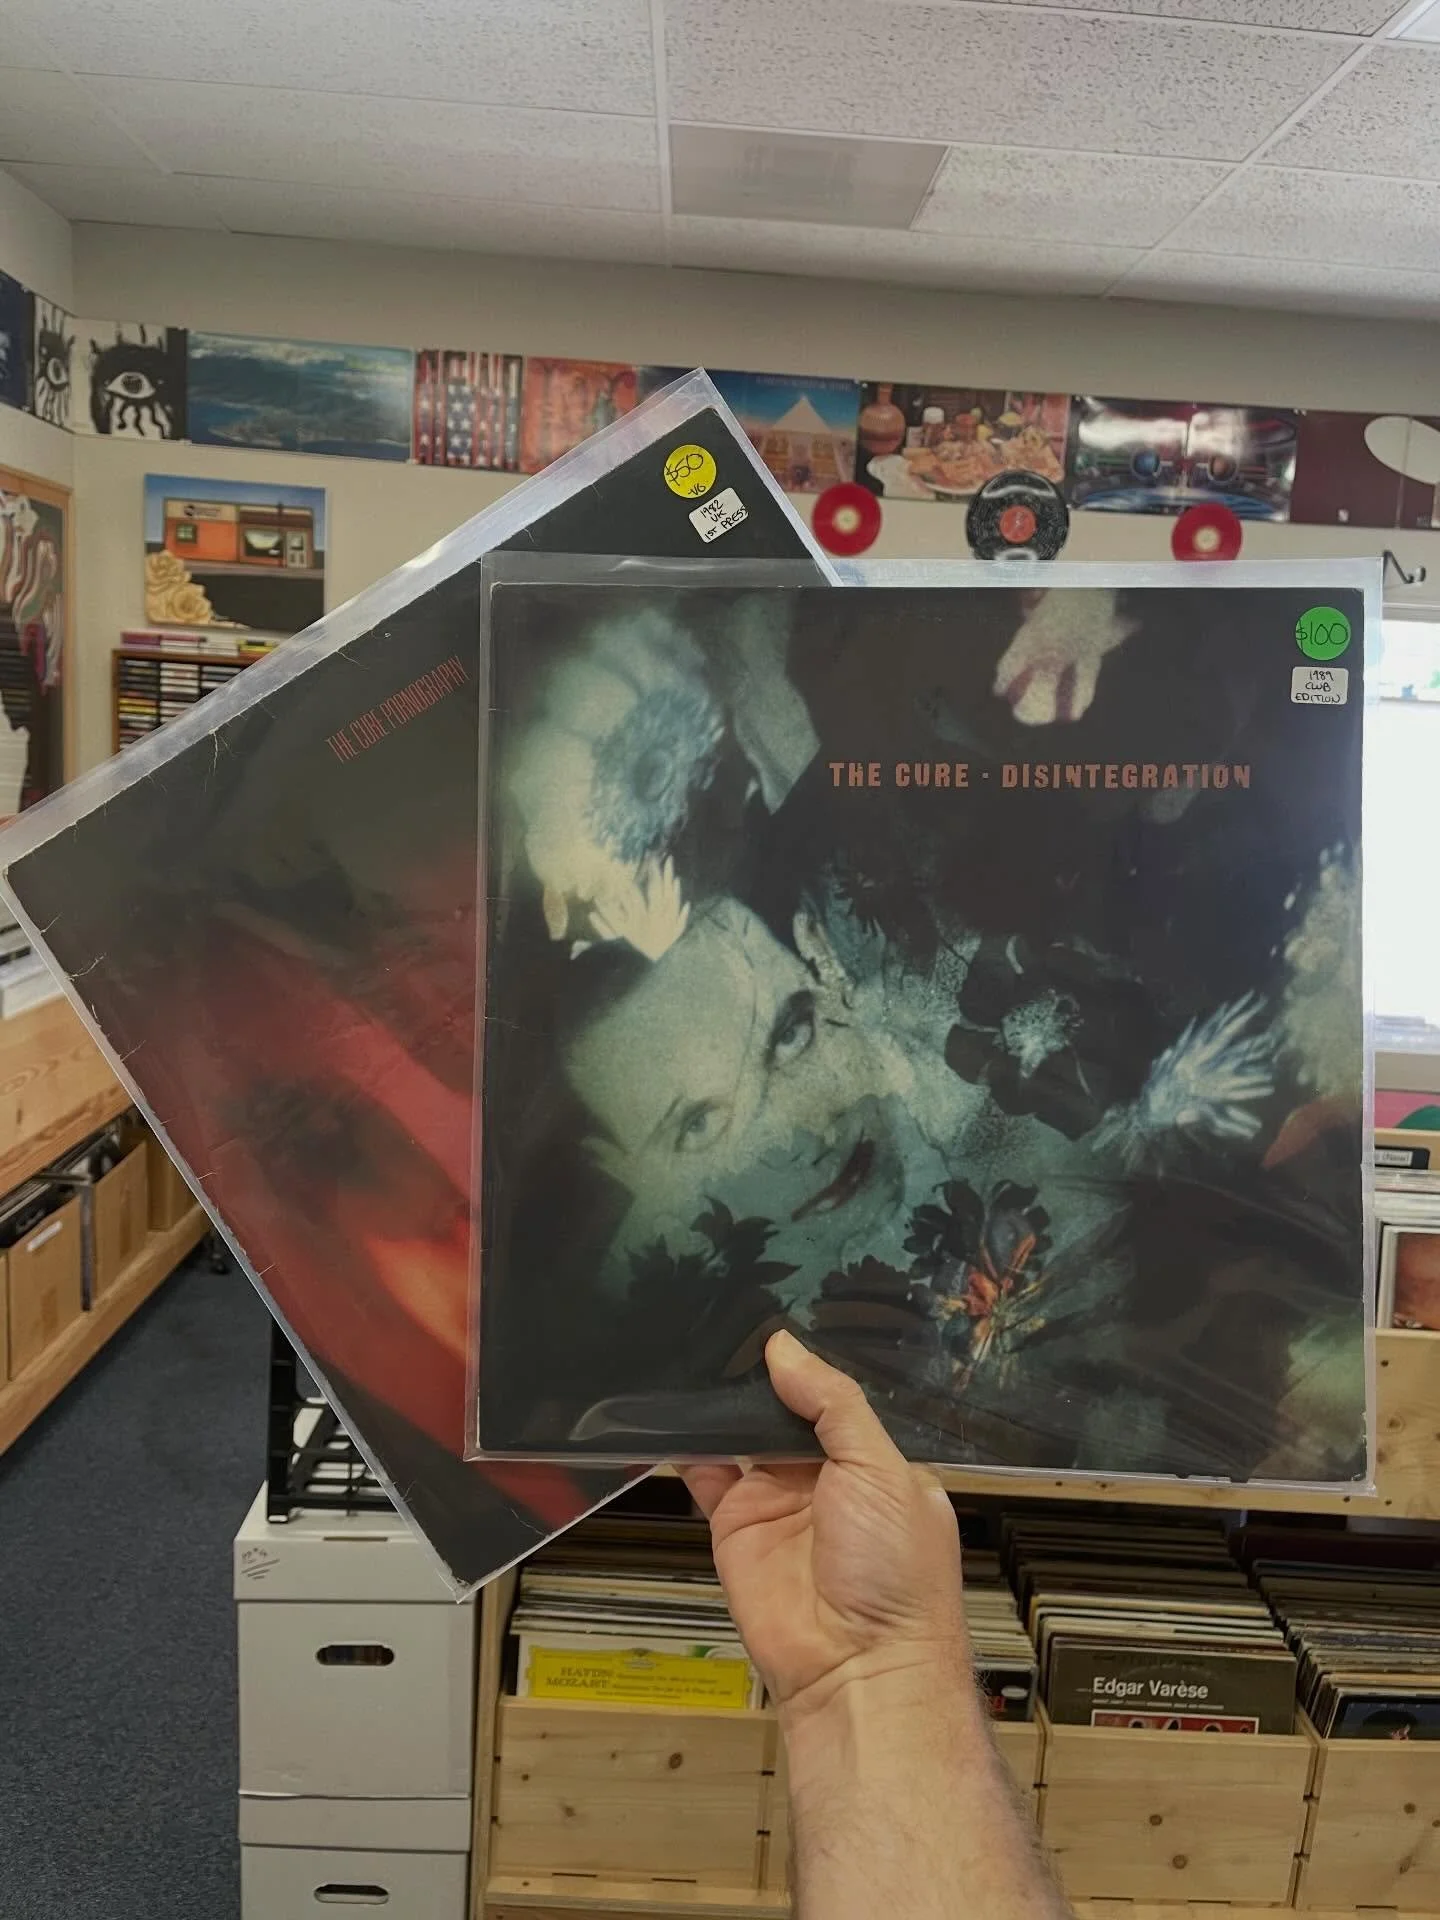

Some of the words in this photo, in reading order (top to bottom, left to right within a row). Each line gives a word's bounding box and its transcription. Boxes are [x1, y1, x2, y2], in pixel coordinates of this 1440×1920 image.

[665, 453, 704, 487] $50
[700, 499, 724, 518] 1982
[710, 510, 727, 522] UK
[720, 505, 749, 529] PRESS
[1296, 620, 1348, 651] $100
[1309, 670, 1335, 681] 1989
[1305, 682, 1332, 692] CLUB
[1295, 692, 1341, 703] EDITION
[325, 728, 359, 763] THE
[350, 709, 391, 749] CURE
[379, 654, 471, 729] PORNOGRAPHY
[829, 762, 881, 787] THE
[895, 763, 969, 788] CURE
[1002, 763, 1250, 789] DISINTEGRATION
[546, 1677, 609, 1689] MOZART
[1092, 1677, 1144, 1698] Edgar
[1149, 1680, 1209, 1699] Varèse
